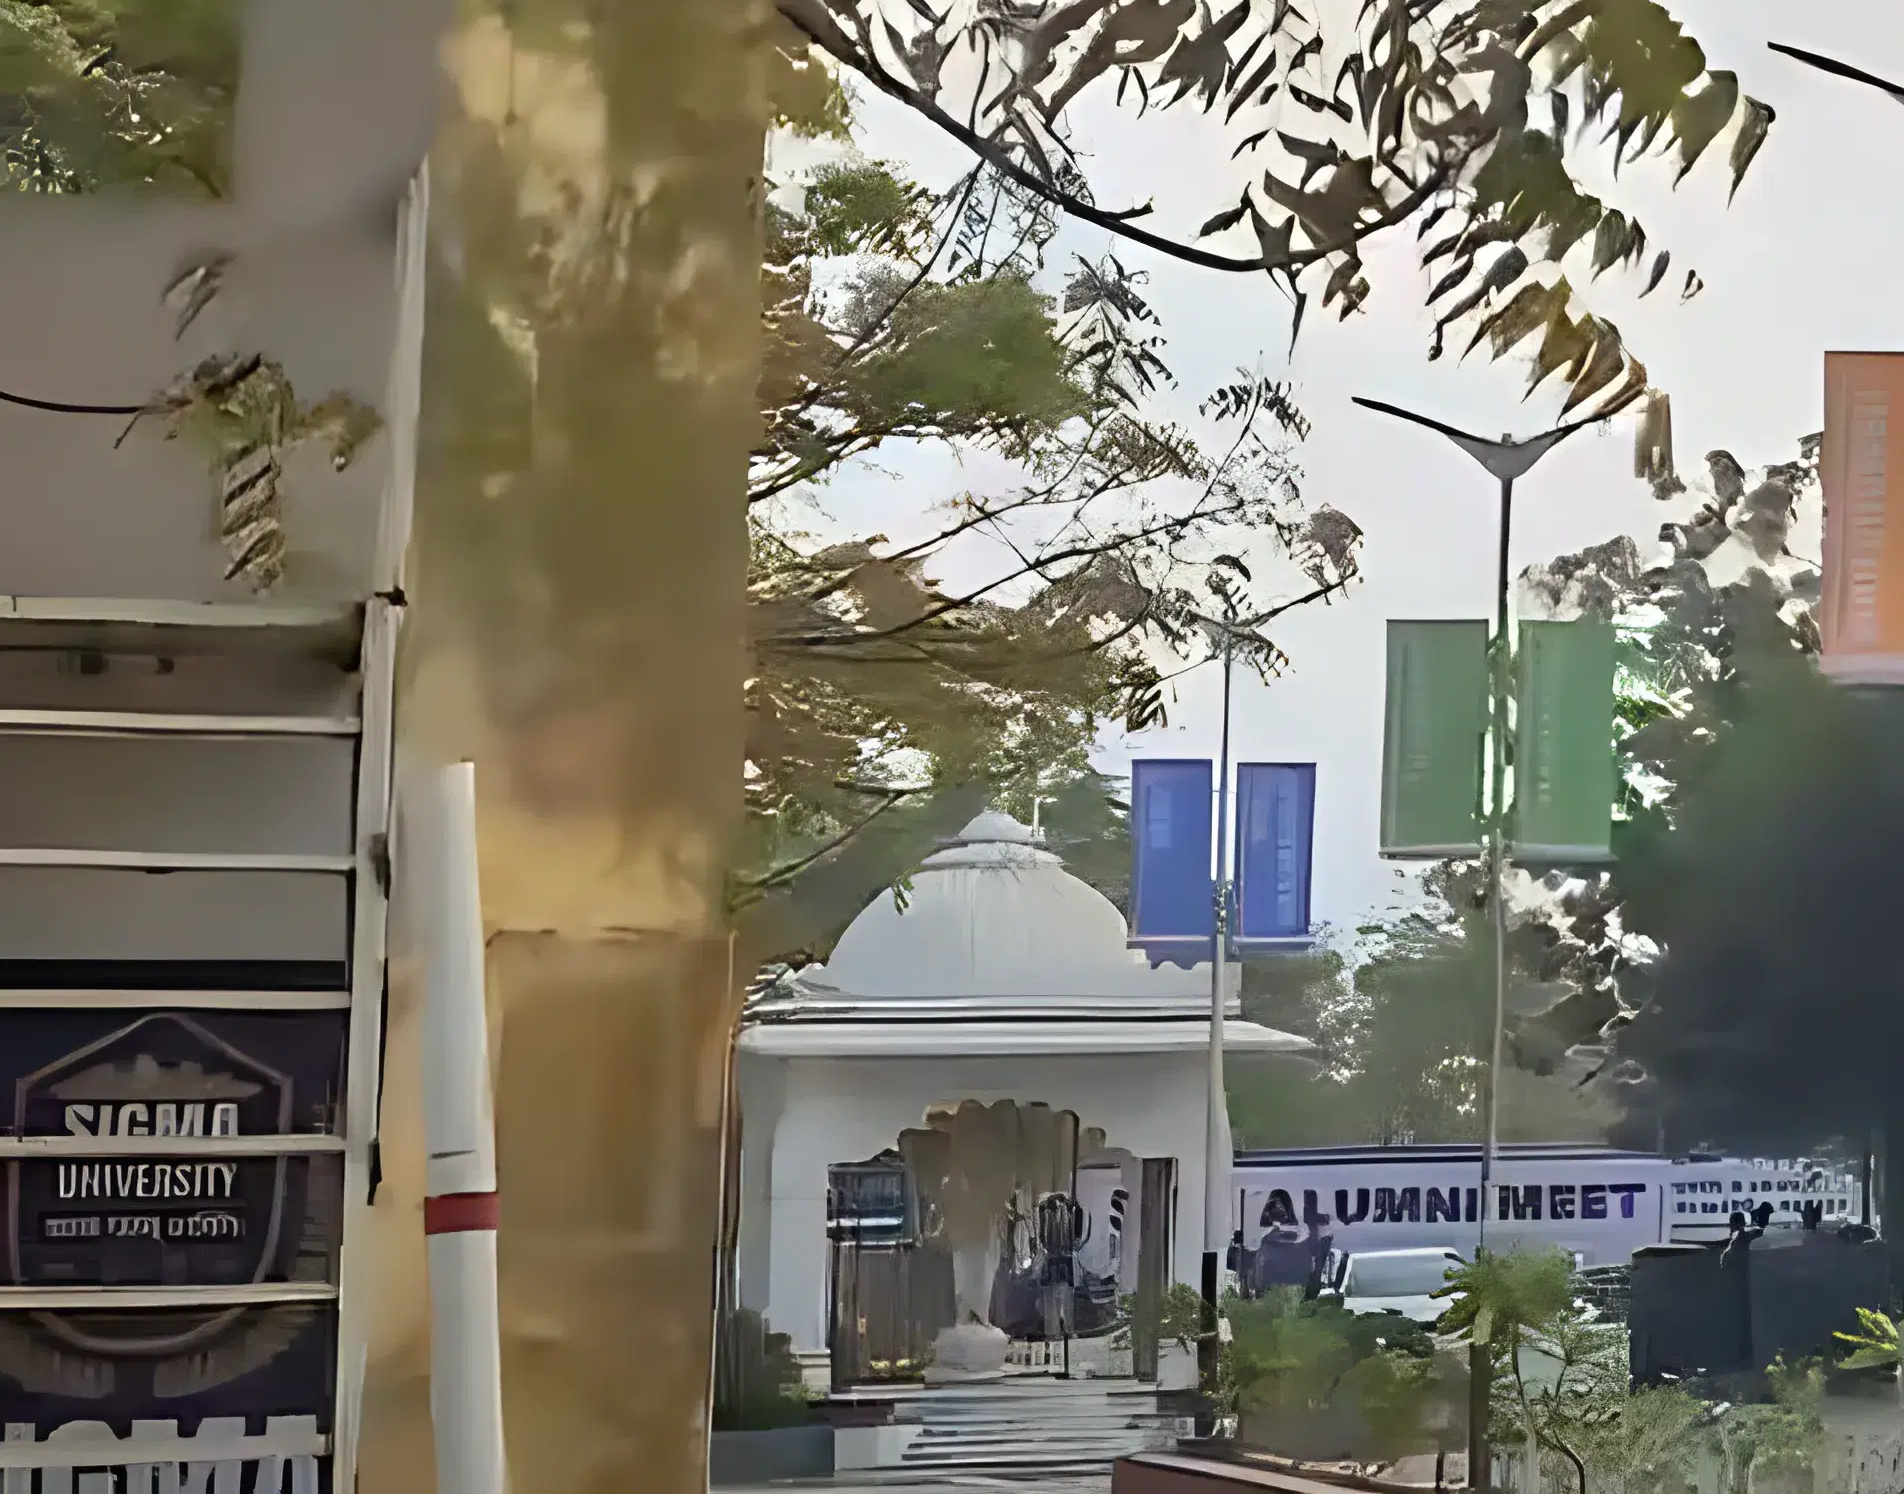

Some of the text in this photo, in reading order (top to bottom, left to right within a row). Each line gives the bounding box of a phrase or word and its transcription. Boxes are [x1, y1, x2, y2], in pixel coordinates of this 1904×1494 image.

[58, 1162, 238, 1199] UNIVERSITY
[1260, 1182, 1646, 1228] ALUMNI MEET
